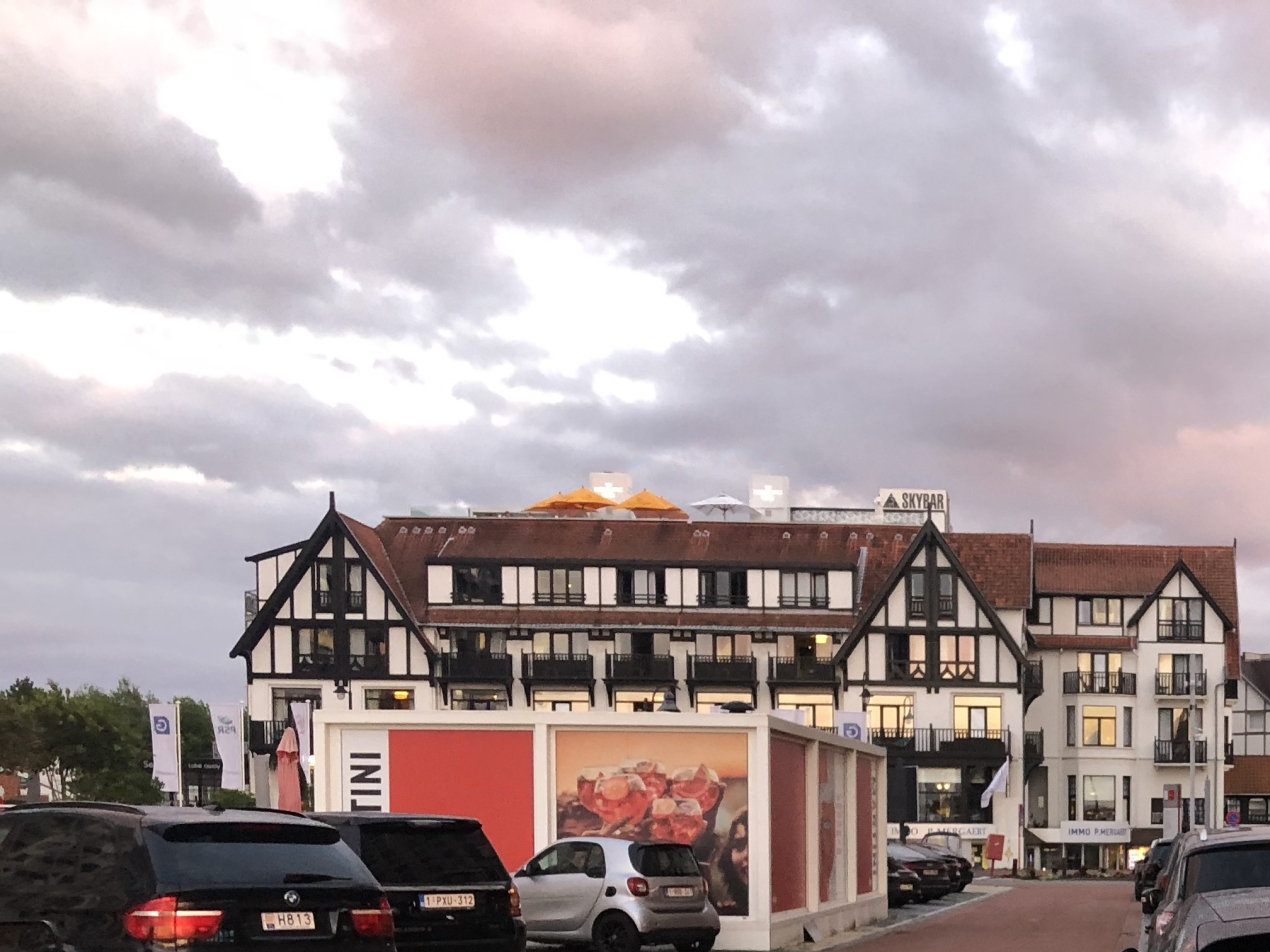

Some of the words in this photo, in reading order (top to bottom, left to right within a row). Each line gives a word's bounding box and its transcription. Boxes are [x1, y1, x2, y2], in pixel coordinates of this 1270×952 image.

[902, 492, 944, 509] SKYBAR
[350, 752, 381, 812] TINI
[1068, 828, 1090, 836] IMMO
[277, 913, 312, 926] H813
